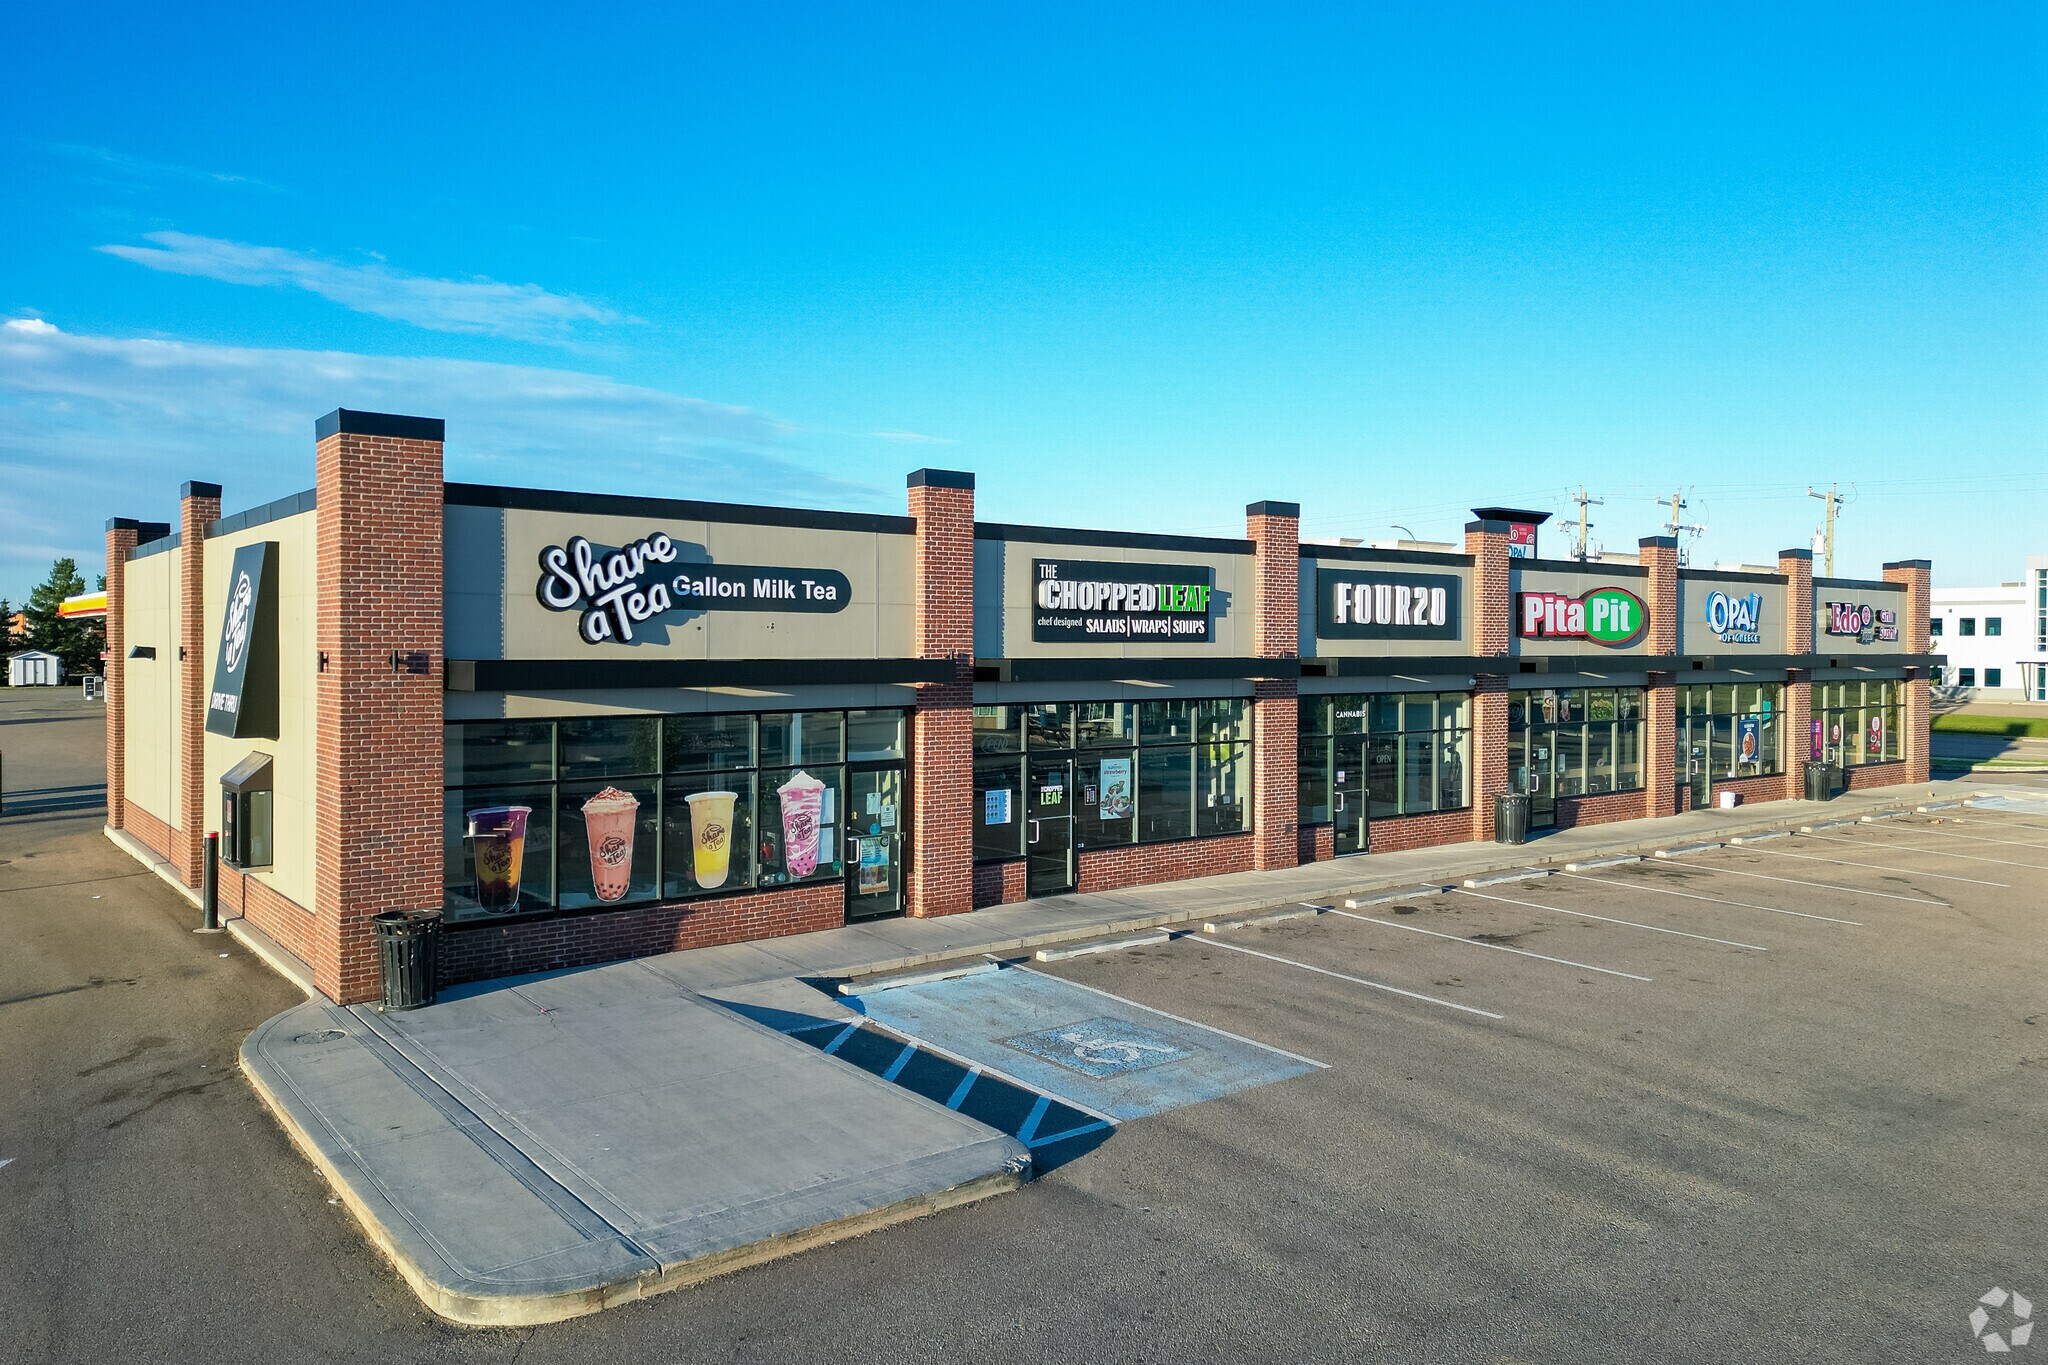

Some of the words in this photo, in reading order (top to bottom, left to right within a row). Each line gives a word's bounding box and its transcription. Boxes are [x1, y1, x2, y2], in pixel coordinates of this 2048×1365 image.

[544, 534, 677, 608] Share
[1039, 563, 1058, 579] THE
[672, 574, 745, 598] Gallon
[752, 578, 796, 600] Milk
[802, 579, 837, 601] Tea
[1039, 579, 1156, 611] CHOPPED
[1158, 583, 1211, 612] LEAF
[594, 582, 672, 642] Tea
[1337, 582, 1447, 627] FOUR20
[1524, 596, 1585, 634] Pita
[1592, 598, 1631, 633] Pit
[1710, 591, 1759, 634] OPA!
[1831, 603, 1861, 634] Edo
[586, 608, 612, 642] a
[1037, 616, 1053, 626] chef
[1053, 616, 1083, 629] designed
[1086, 618, 1126, 634] SALADS
[1132, 619, 1168, 634] WRAPS
[1172, 619, 1206, 634] SOUPS
[1335, 710, 1367, 719] CANNABIS
[1376, 754, 1392, 764] OPEN
[1040, 791, 1063, 806] LEAF
[600, 839, 627, 858] Share
[701, 827, 726, 845] Share
